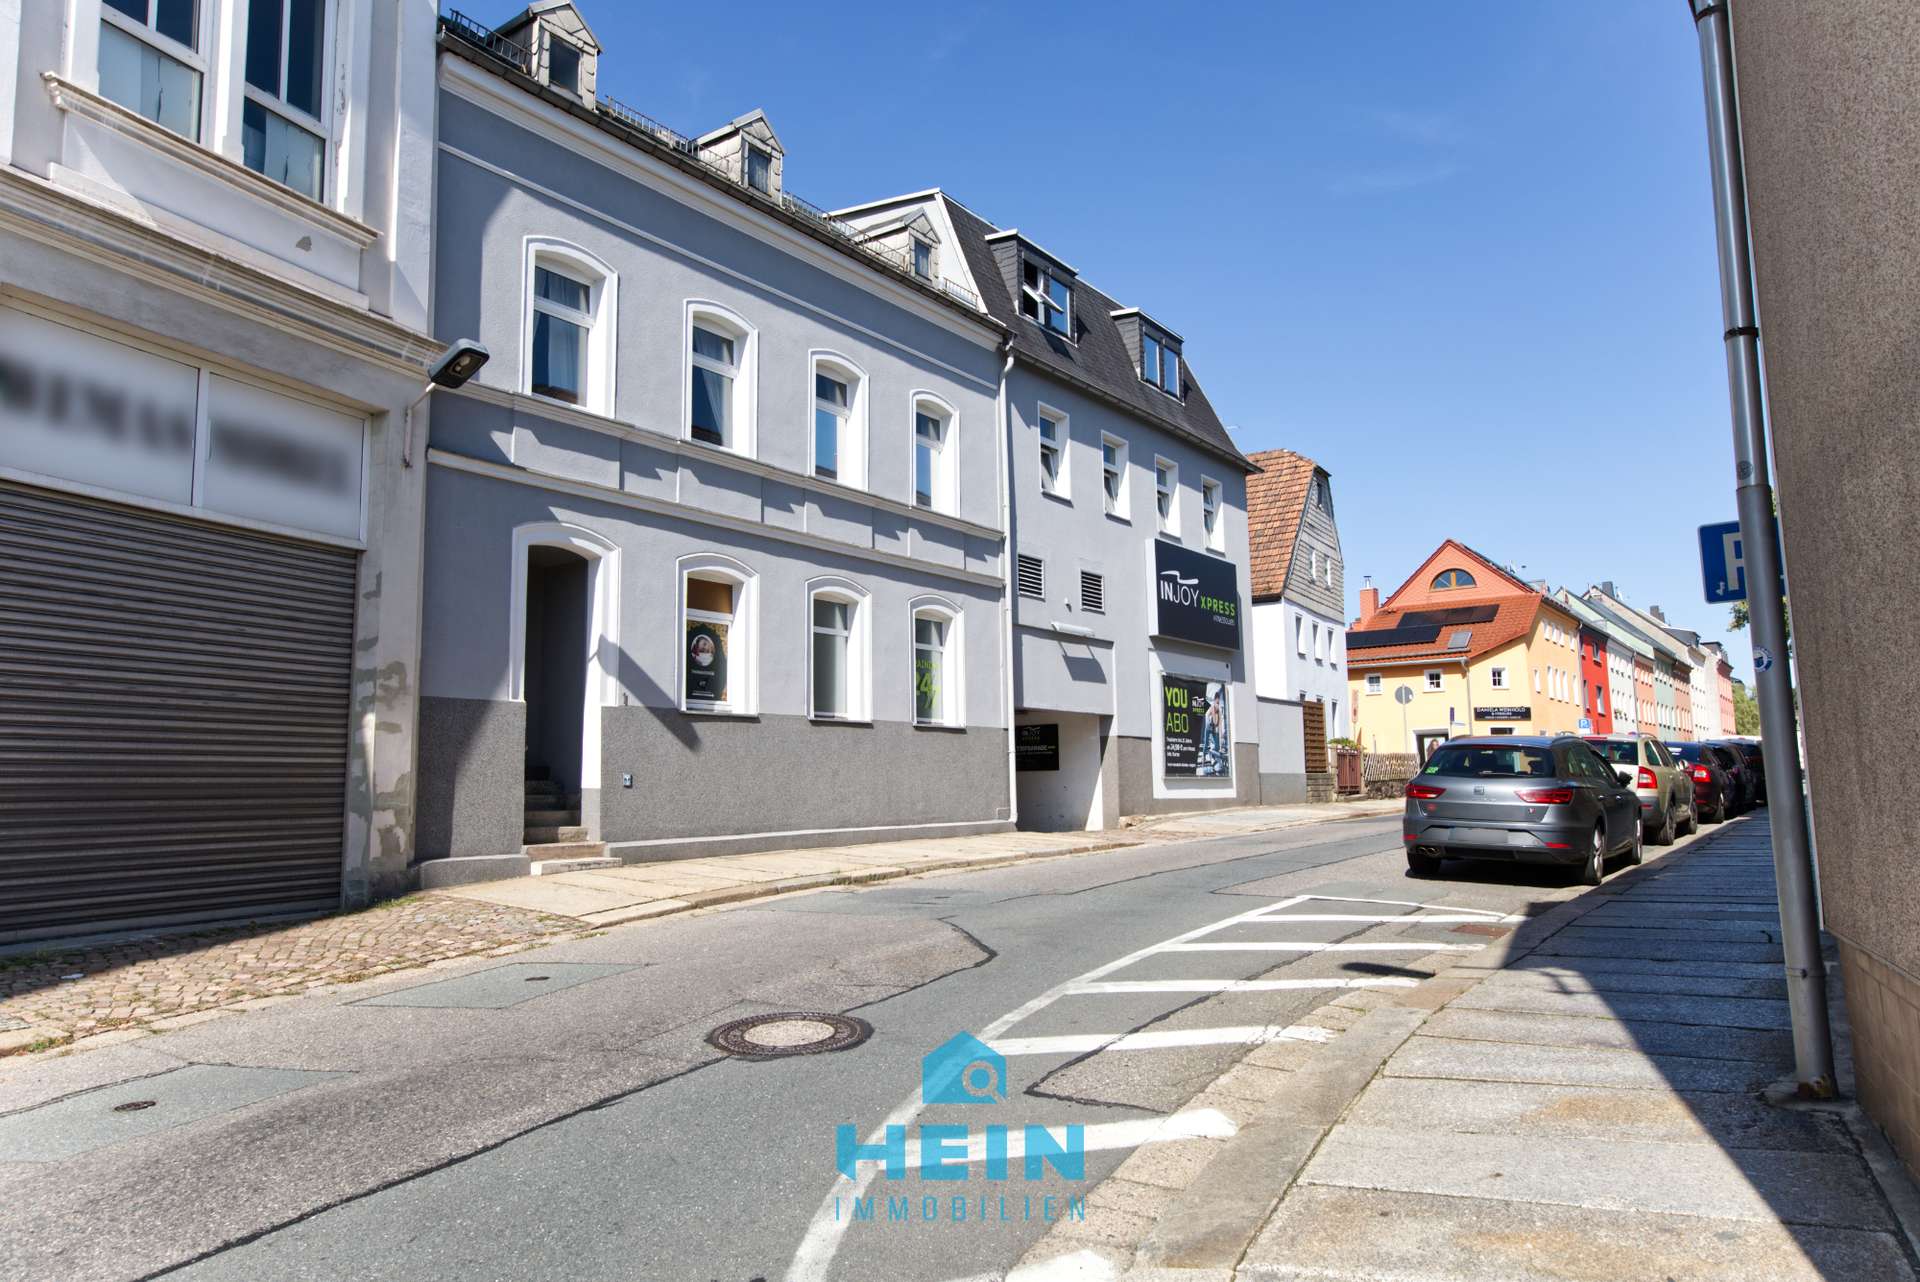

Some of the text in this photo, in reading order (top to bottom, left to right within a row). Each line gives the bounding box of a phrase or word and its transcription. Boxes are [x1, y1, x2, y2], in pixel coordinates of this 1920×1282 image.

[1160, 580, 1199, 608] INJOY
[1201, 595, 1235, 616] XPRESS
[1165, 686, 1188, 708] YOU
[1166, 711, 1188, 733] ABO
